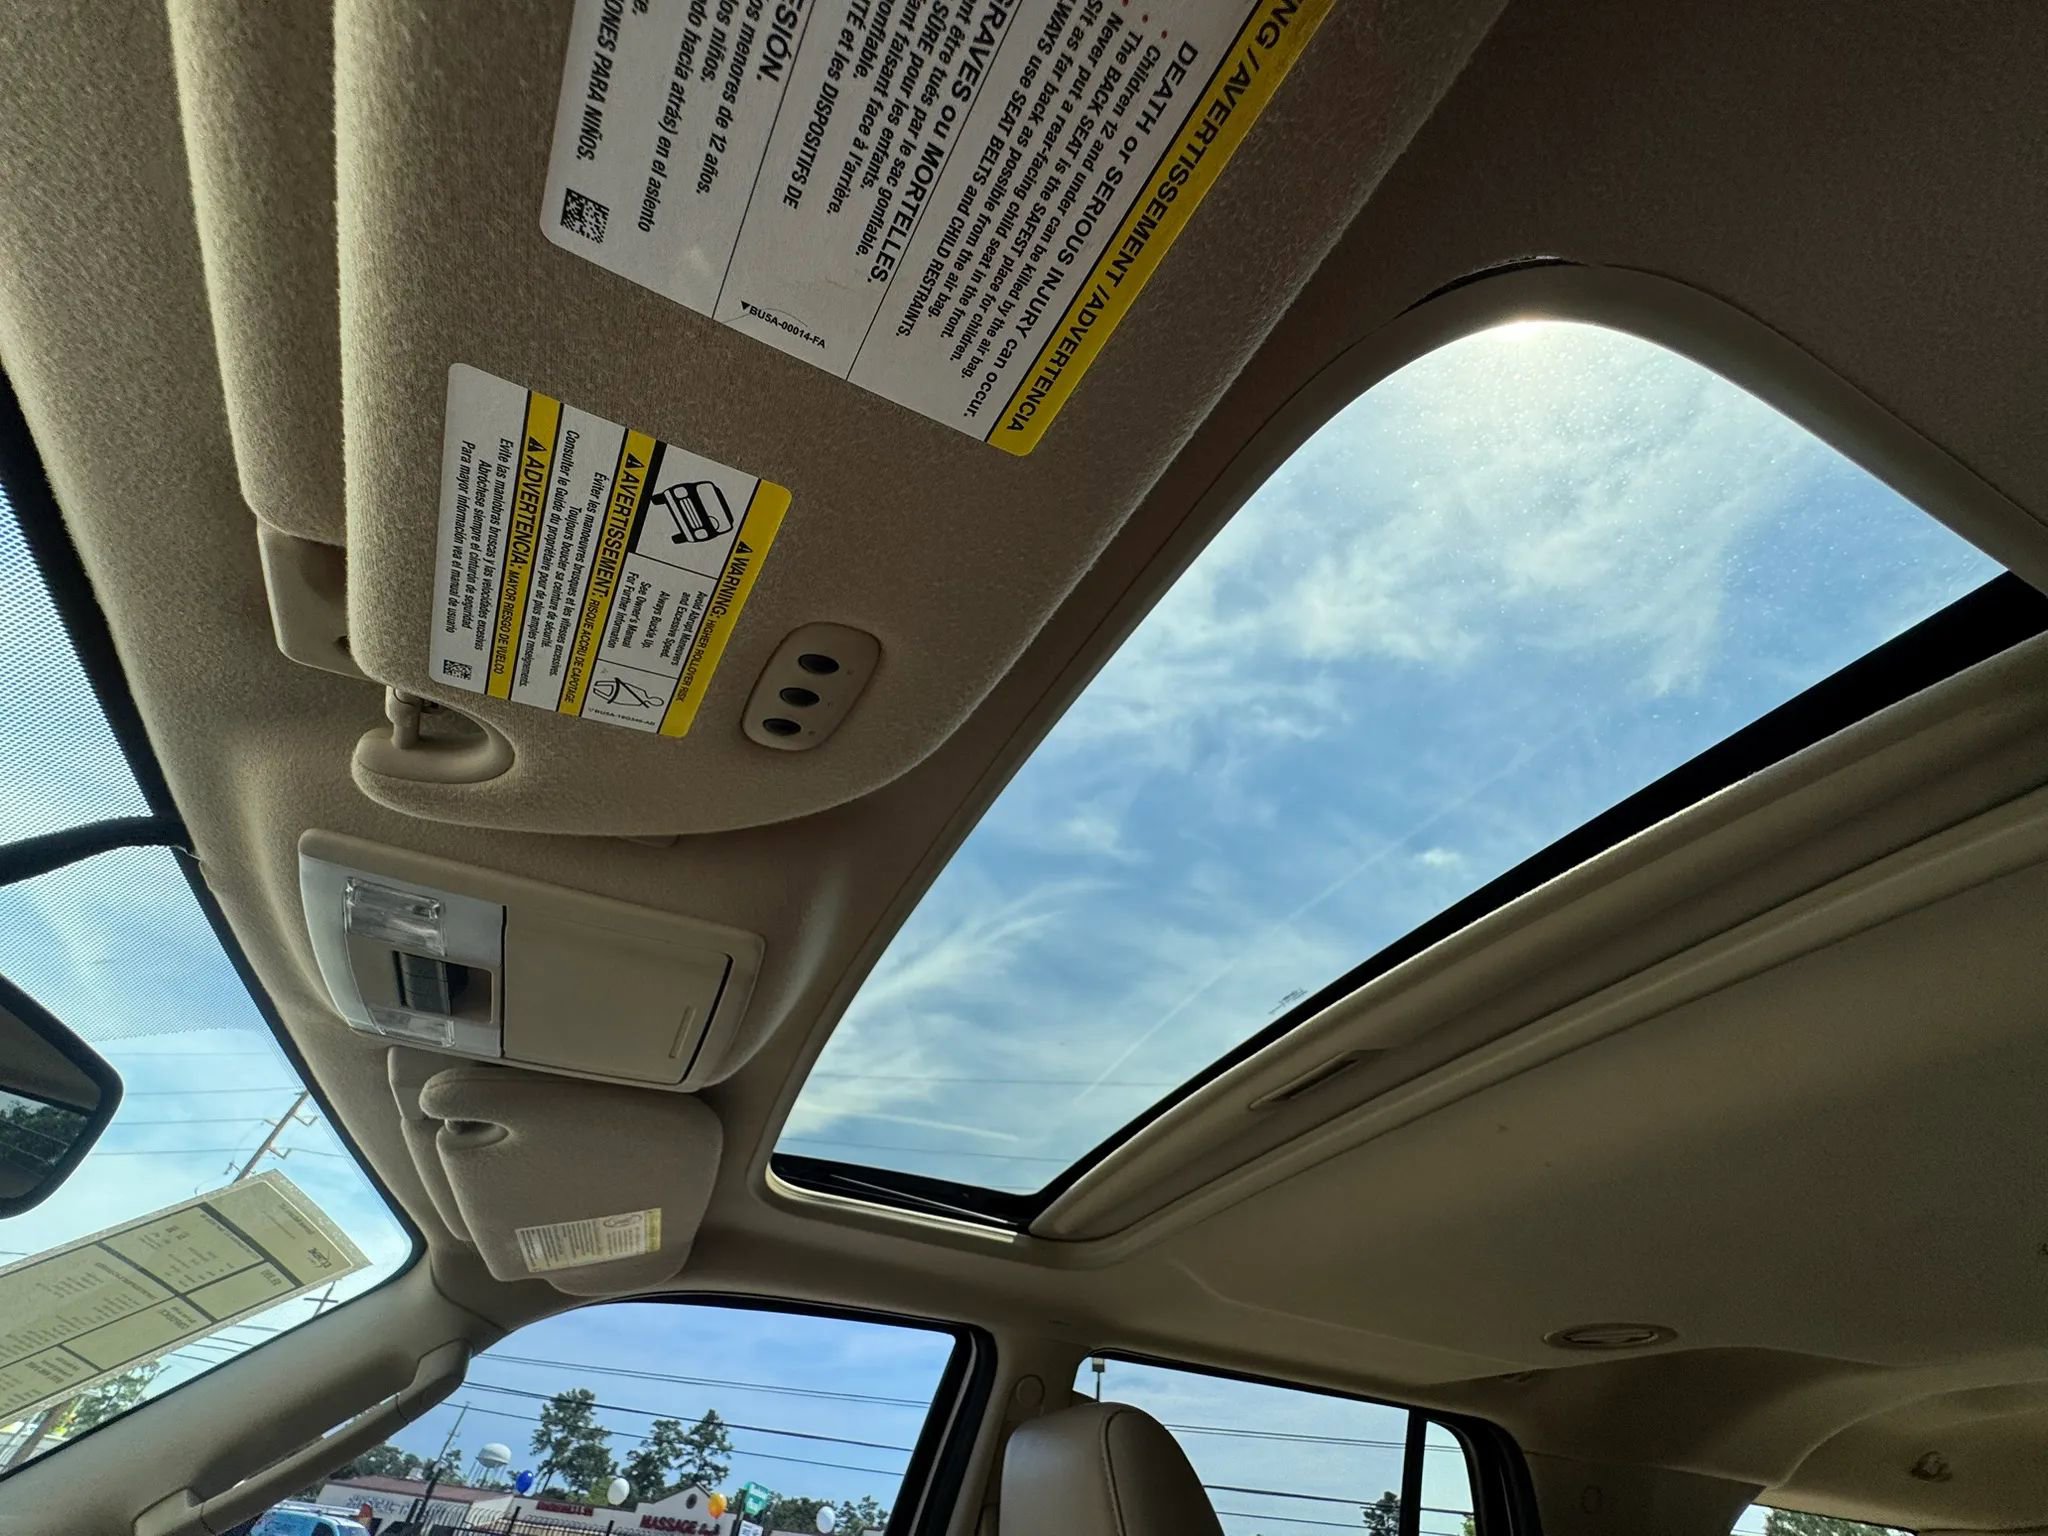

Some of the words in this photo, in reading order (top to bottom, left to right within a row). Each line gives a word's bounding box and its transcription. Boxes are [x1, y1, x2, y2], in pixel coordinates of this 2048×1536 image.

[596, 0, 625, 53] ONES
[916, 0, 950, 56] SÛRE
[1037, 0, 1077, 56] WAYS
[1079, 0, 1104, 27] Sit
[674, 27, 702, 81] hacia
[700, 26, 727, 82] niños.
[837, 27, 855, 52] et
[938, 24, 966, 65] être
[951, 0, 1015, 103] RAVES
[1066, 25, 1085, 52] as
[1087, 11, 1124, 68] Never
[1115, 30, 1144, 66] The
[587, 51, 613, 104] PARA
[722, 21, 756, 105] menores
[827, 50, 850, 82] les
[873, 31, 910, 98] faisant
[899, 50, 925, 99] pour
[1019, 54, 1043, 89] use
[1051, 52, 1074, 83] far
[920, 66, 948, 107] tués
[1068, 64, 1092, 101] put
[1086, 64, 1123, 118] BACK
[1112, 44, 1161, 118] Children
[1135, 40, 1199, 136] DEATH
[657, 81, 686, 135] atrás)
[715, 105, 734, 130] de
[858, 97, 884, 137] face
[887, 97, 910, 126] les
[997, 89, 1027, 138] SEAT
[1027, 80, 1060, 126] back
[1060, 99, 1074, 114] a
[576, 104, 603, 161] NIÑOS.
[791, 81, 839, 185] DISPOSITIFS
[907, 104, 928, 140] par
[933, 104, 957, 140] ou
[1016, 125, 1034, 148] as
[1065, 114, 1095, 160] SEAT
[1100, 119, 1118, 140] 12
[655, 135, 672, 159] en
[708, 132, 728, 154] 12
[852, 136, 869, 151] à
[859, 127, 894, 189] enfants.
[899, 138, 917, 157] le
[1013, 114, 1067, 201] rear-facing
[1081, 139, 1104, 173] and
[1118, 135, 1138, 165] or
[651, 159, 668, 179] el
[696, 152, 719, 194] años.
[886, 157, 906, 188] sac
[972, 134, 1006, 186] BELTS
[1054, 157, 1072, 175] is
[826, 151, 863, 214] l'arrière.
[983, 146, 1023, 212] possible
[1039, 175, 1062, 202] the
[1057, 171, 1087, 217] under
[637, 176, 662, 233] asiento
[782, 184, 803, 210] DE
[867, 141, 945, 283] MORTELLES.
[956, 184, 978, 217] and
[855, 186, 893, 256] gonflable.
[965, 212, 992, 247] from
[994, 201, 1020, 240] child
[1010, 202, 1047, 258] SAFEST
[1040, 216, 1061, 244] can
[1057, 166, 1124, 266] SERIOUS
[936, 216, 965, 259] CHILD
[978, 237, 1001, 270] seat
[1029, 243, 1048, 263] be
[953, 248, 974, 272] the
[970, 268, 987, 284] in
[989, 254, 1015, 293] place
[895, 258, 945, 337] RESTRAINTS.
[943, 271, 959, 293] air
[958, 284, 979, 307] the
[1008, 262, 1037, 301] killed
[927, 291, 952, 318] bag.
[978, 292, 997, 314] for
[997, 299, 1016, 318] by
[1015, 266, 1065, 340] INJURY
[940, 307, 966, 338] front.
[949, 312, 983, 361] children.
[986, 317, 1006, 338] the
[976, 338, 991, 356] air
[993, 338, 1018, 369] can
[961, 355, 984, 379] bag.
[963, 371, 998, 418] occur.
[460, 440, 476, 464] Para
[497, 437, 514, 463] Evite
[559, 429, 580, 477] Consulter
[455, 464, 471, 495] mayor
[474, 459, 493, 508] Abróchese
[495, 463, 511, 479] las
[557, 476, 571, 487] le
[589, 471, 610, 500] Éviter
[489, 479, 506, 526] maniobras
[552, 487, 569, 513] Guide
[586, 499, 601, 514] les
[453, 493, 471, 545] información
[549, 512, 563, 526] du
[563, 505, 583, 541] Toujours
[470, 542, 482, 553] el
[485, 525, 502, 559] bruscas
[540, 524, 559, 572] propriétaire
[557, 541, 574, 572] boucler
[483, 564, 497, 578] las
[503, 569, 521, 602] MAYOR
[566, 562, 586, 597] brusques
[626, 571, 640, 586] For
[465, 583, 478, 594] de
[535, 589, 548, 600] de
[564, 597, 577, 606] et
[618, 584, 636, 612] Further
[637, 581, 652, 596] See
[652, 590, 671, 616] Always
[679, 591, 691, 607] and
[692, 590, 708, 611] Avoid
[499, 601, 515, 633] RIESGO
[546, 610, 558, 621] de
[562, 605, 576, 617] les
[583, 598, 601, 630] RISQUE
[629, 595, 647, 624] Owner's
[667, 605, 688, 638] Excessive
[683, 609, 701, 633] Abrupt
[497, 632, 510, 645] DE
[576, 628, 592, 657] ACCRU
[607, 611, 628, 649] Information
[621, 623, 639, 649] Manual
[645, 615, 663, 639] Buckle
[696, 618, 717, 649] HIGHER
[573, 656, 585, 668] DE
[670, 632, 692, 666] Maneuvers
[640, 1514, 699, 1535] MASSAGE
